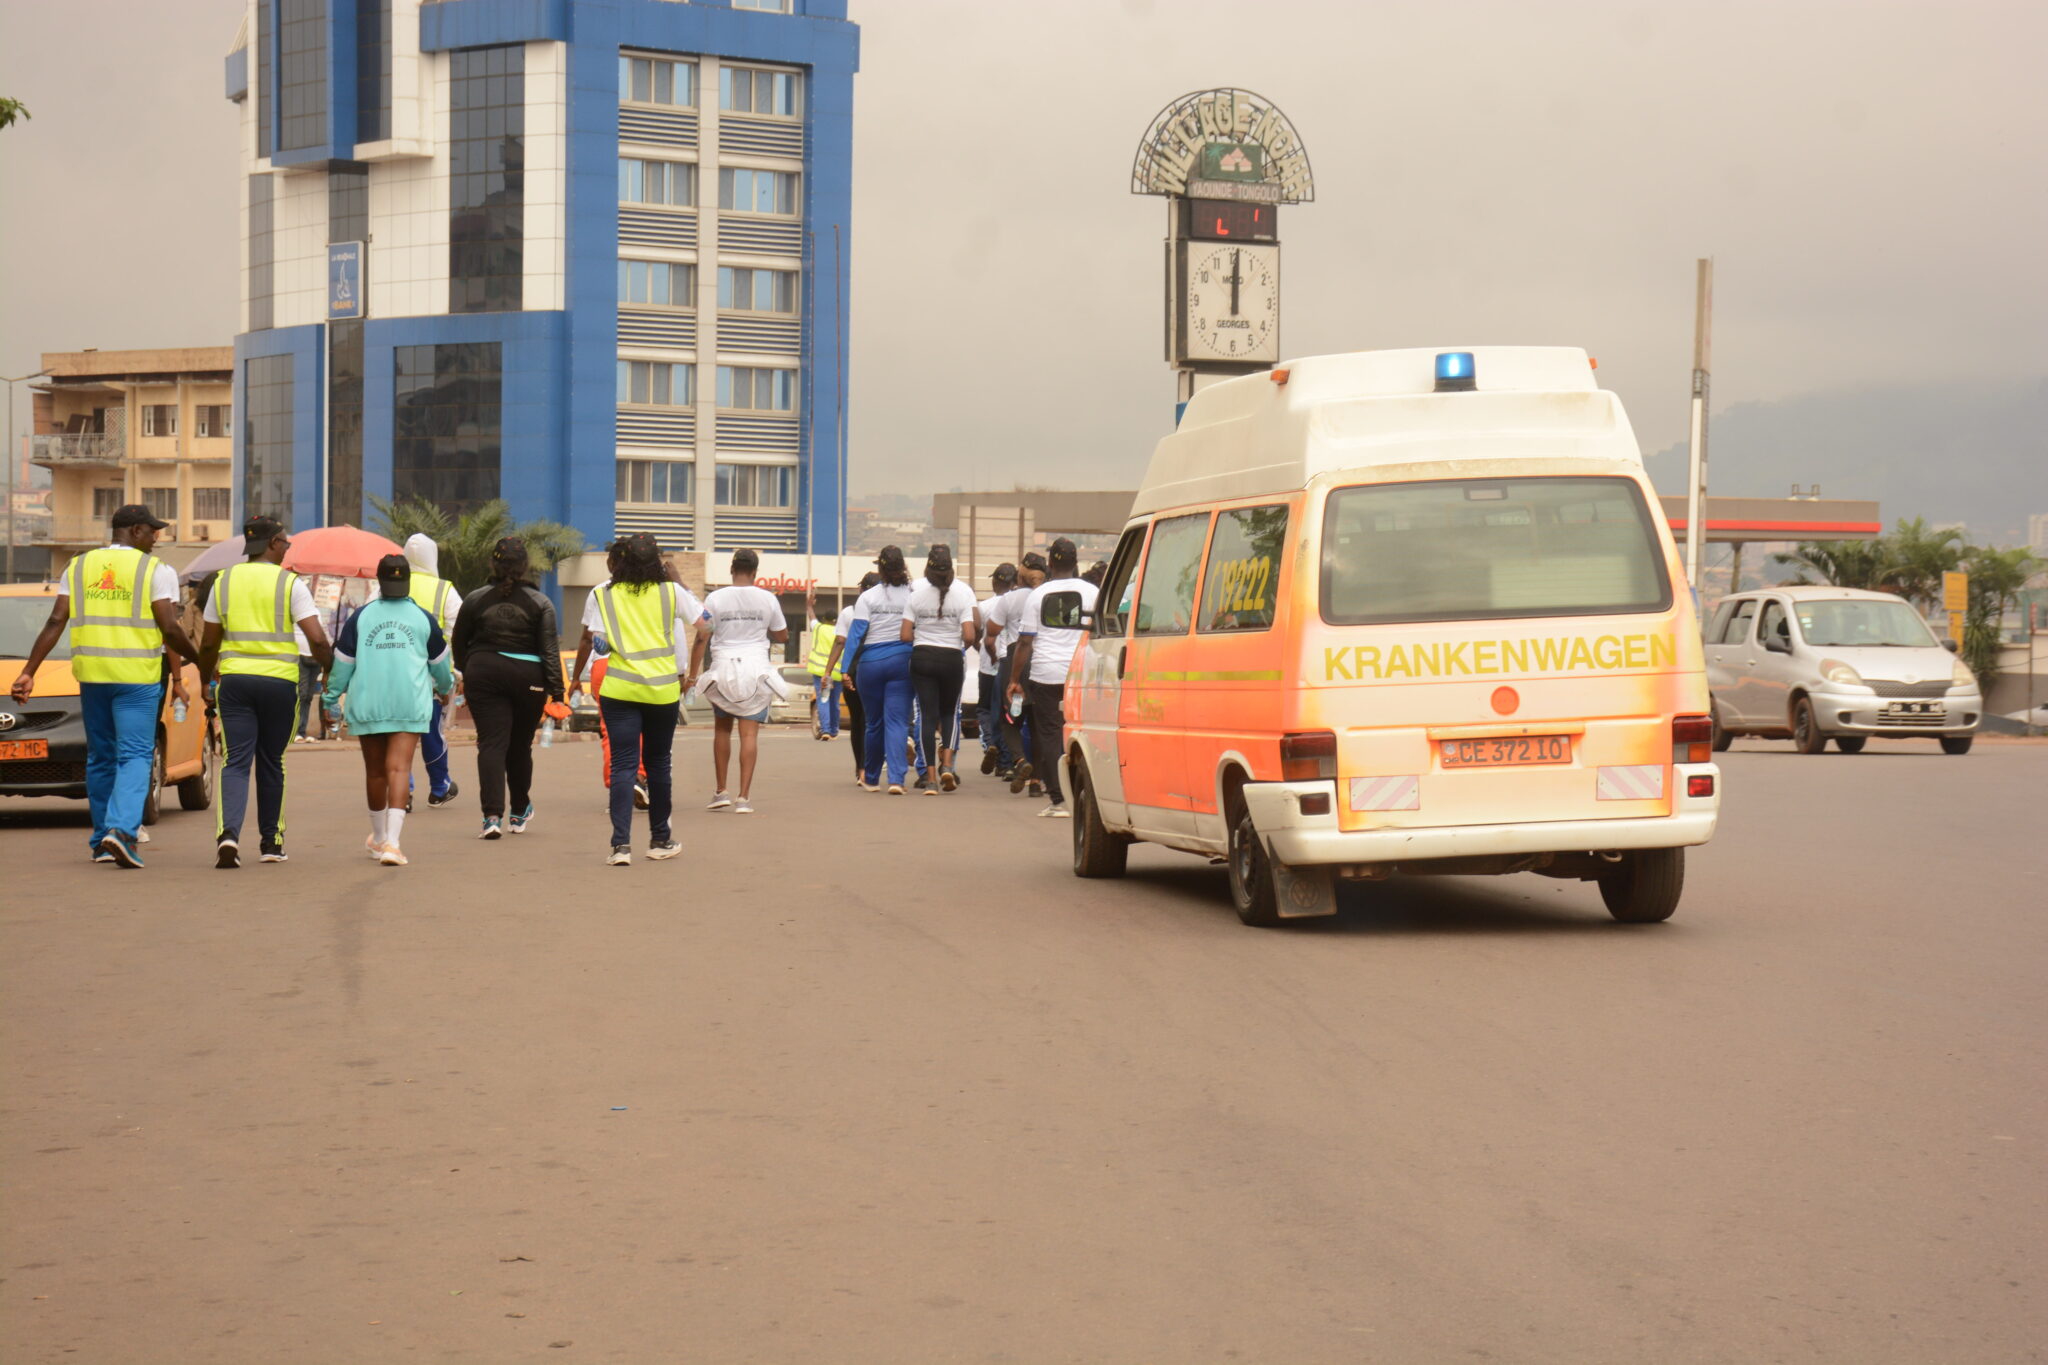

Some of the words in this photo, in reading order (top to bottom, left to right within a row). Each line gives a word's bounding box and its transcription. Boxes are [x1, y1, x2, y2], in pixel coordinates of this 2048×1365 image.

[1153, 94, 1250, 194] VILLAGE
[1252, 107, 1313, 200] NOAH
[1213, 257, 1220, 270] 11
[1200, 271, 1209, 283] 10
[1261, 274, 1267, 286] 2
[1193, 294, 1199, 306] 9
[1266, 298, 1272, 310] 3
[1200, 318, 1206, 330] 8
[1216, 320, 1250, 329] GEORGES
[1260, 320, 1266, 332] 4
[1212, 333, 1218, 345] 7
[1248, 334, 1253, 346] 5
[1230, 340, 1236, 352] 6
[752, 573, 818, 596] onjour
[1218, 556, 1270, 613] 19222
[1324, 633, 1677, 681] KRANKENWAGEN
[1459, 742, 1488, 763] CE
[1491, 740, 1532, 762] 372
